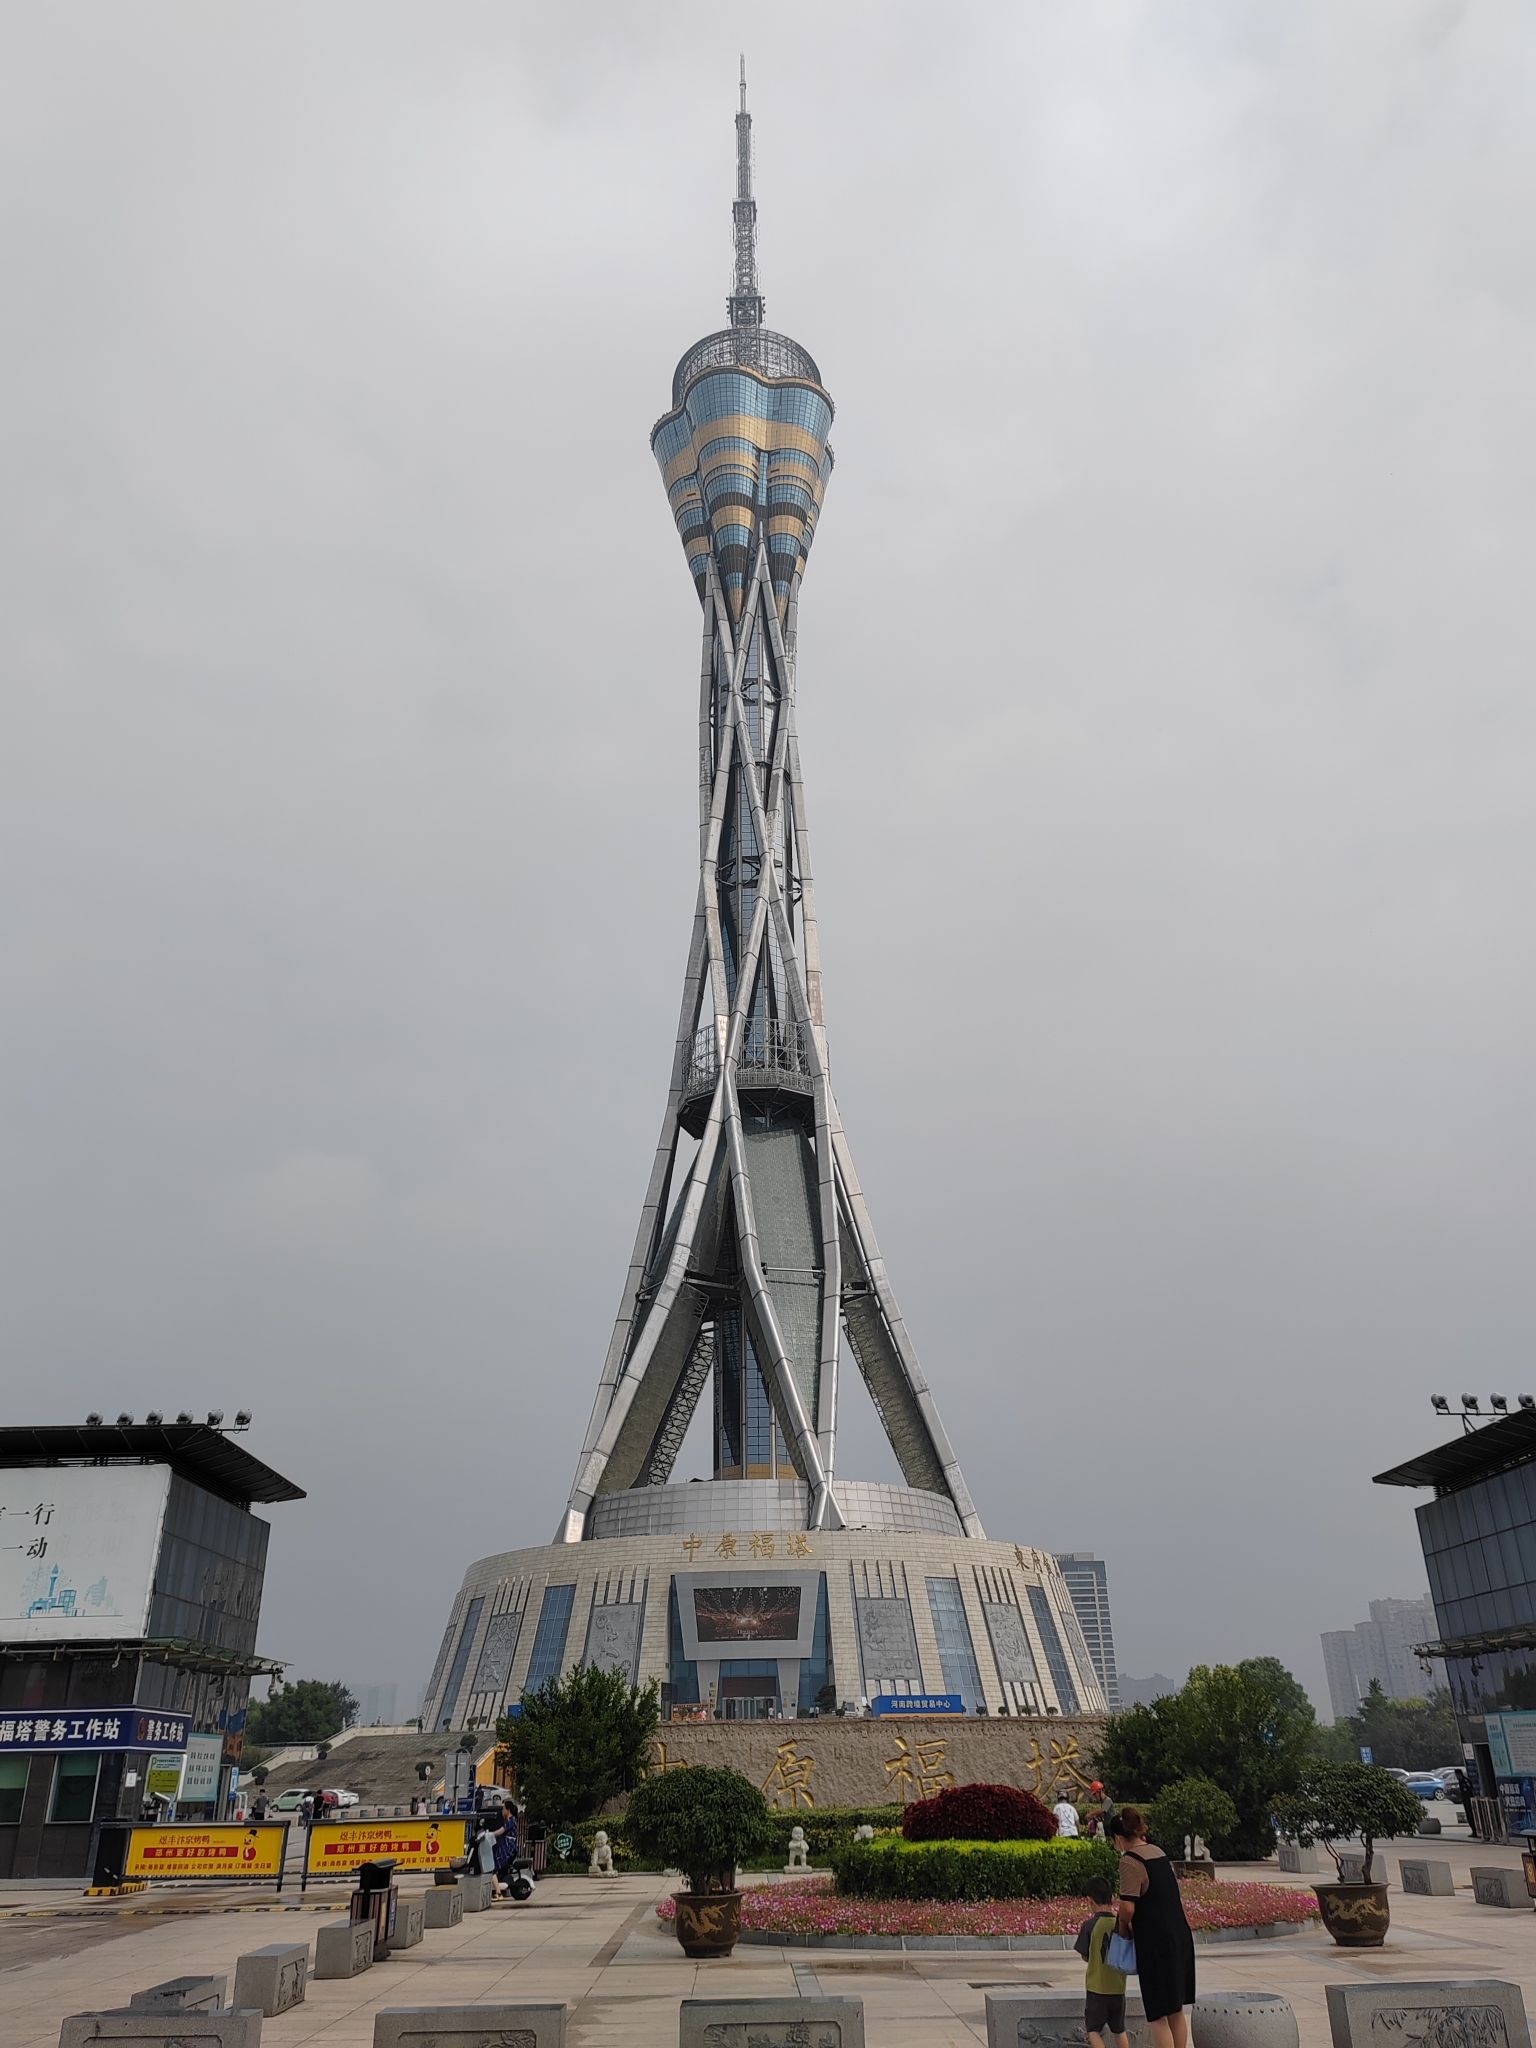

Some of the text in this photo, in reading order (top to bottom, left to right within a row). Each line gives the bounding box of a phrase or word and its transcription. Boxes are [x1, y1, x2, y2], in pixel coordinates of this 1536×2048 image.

[682, 1533, 813, 1562] 中原福塔
[890, 1699, 951, 1709] 河南跨境贸易中心
[0, 1717, 121, 1742] 福塔警务工作站
[146, 1718, 184, 1742] 警务工作站
[155, 1848, 227, 1857] 郑州更好的烤鸭
[336, 1842, 410, 1853] 郑州更好的烤鸭
